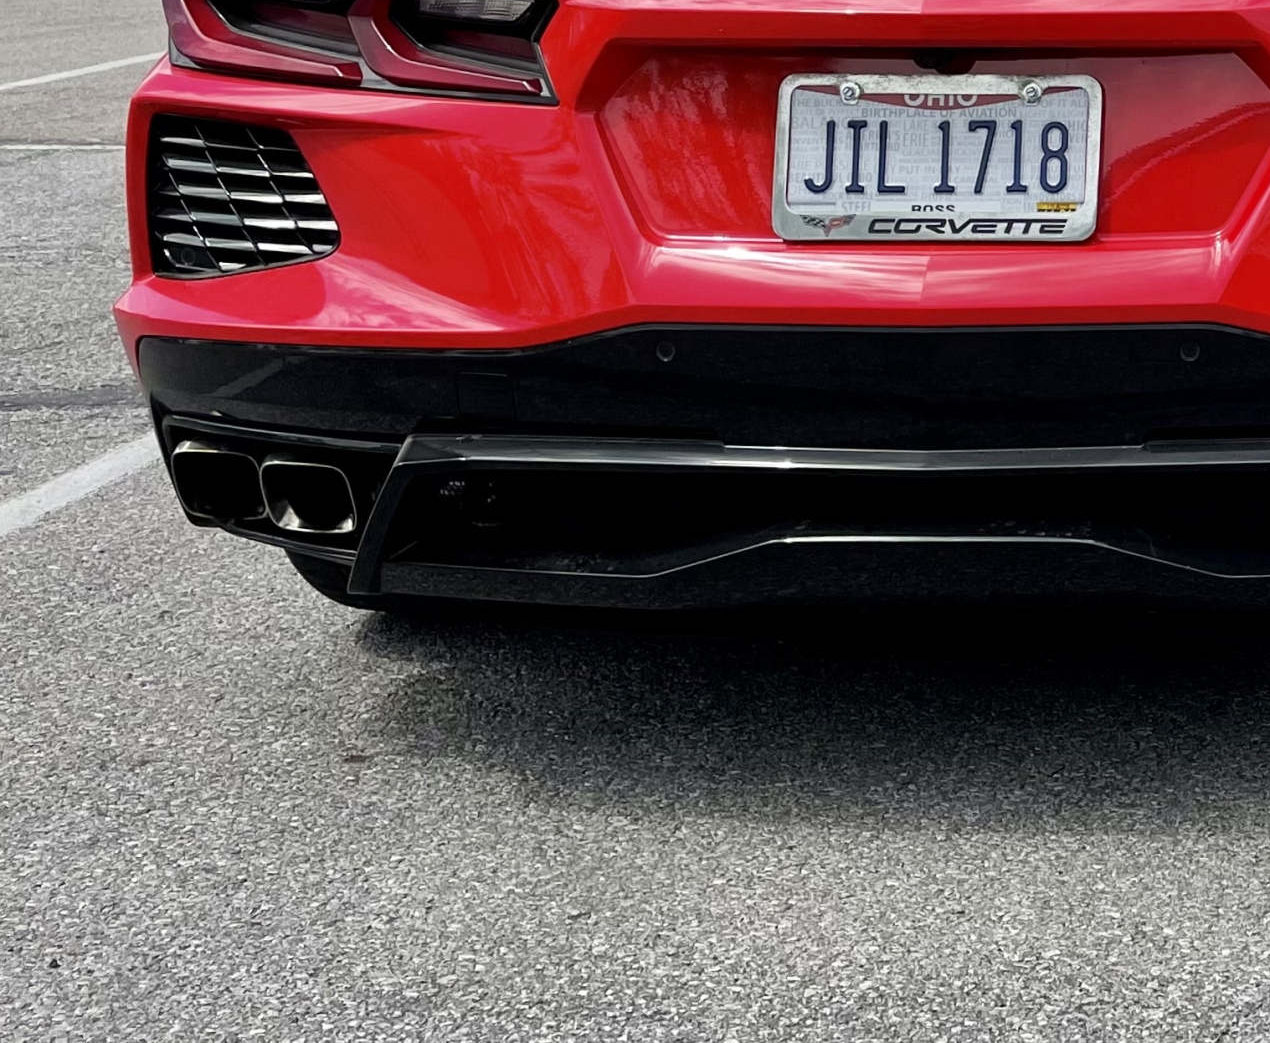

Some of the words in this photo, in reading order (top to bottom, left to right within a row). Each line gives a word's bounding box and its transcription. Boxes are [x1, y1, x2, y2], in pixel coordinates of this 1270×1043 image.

[860, 107, 936, 119] BIRTHPLACE
[957, 107, 1017, 118] AVIATION
[804, 120, 906, 193] JIL
[933, 120, 1069, 194] 1718
[868, 218, 1068, 235] CORVETTE
